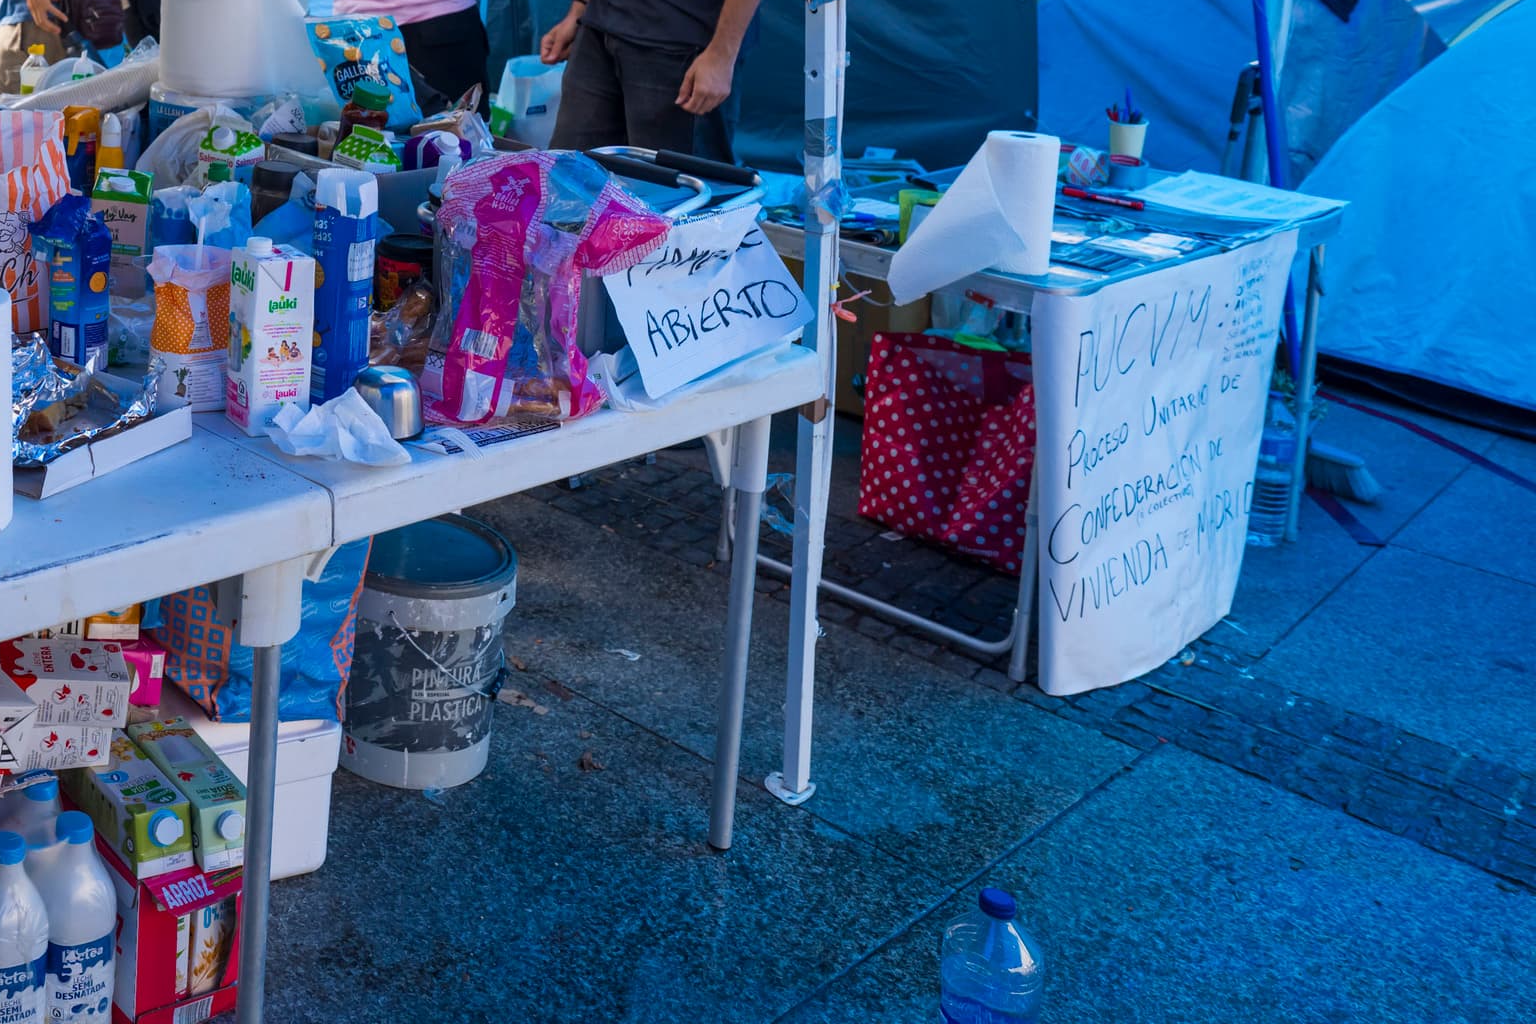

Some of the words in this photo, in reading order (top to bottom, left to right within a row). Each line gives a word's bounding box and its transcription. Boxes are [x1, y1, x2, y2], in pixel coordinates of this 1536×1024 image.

[1075, 285, 1211, 407] PUCVM
[1067, 423, 1129, 488] PROCESO
[1143, 384, 1209, 437] UNITARIO
[1221, 374, 1241, 394] DE
[1209, 437, 1223, 461] DE
[1050, 532, 1168, 622] VIVIENDA
[412, 663, 481, 689] PINTURA
[162, 874, 215, 909] ARROZ
[56, 982, 105, 1000] DESNATADA
[72, 980, 93, 992] SEMI
[0, 1006, 22, 1016] SEMI
